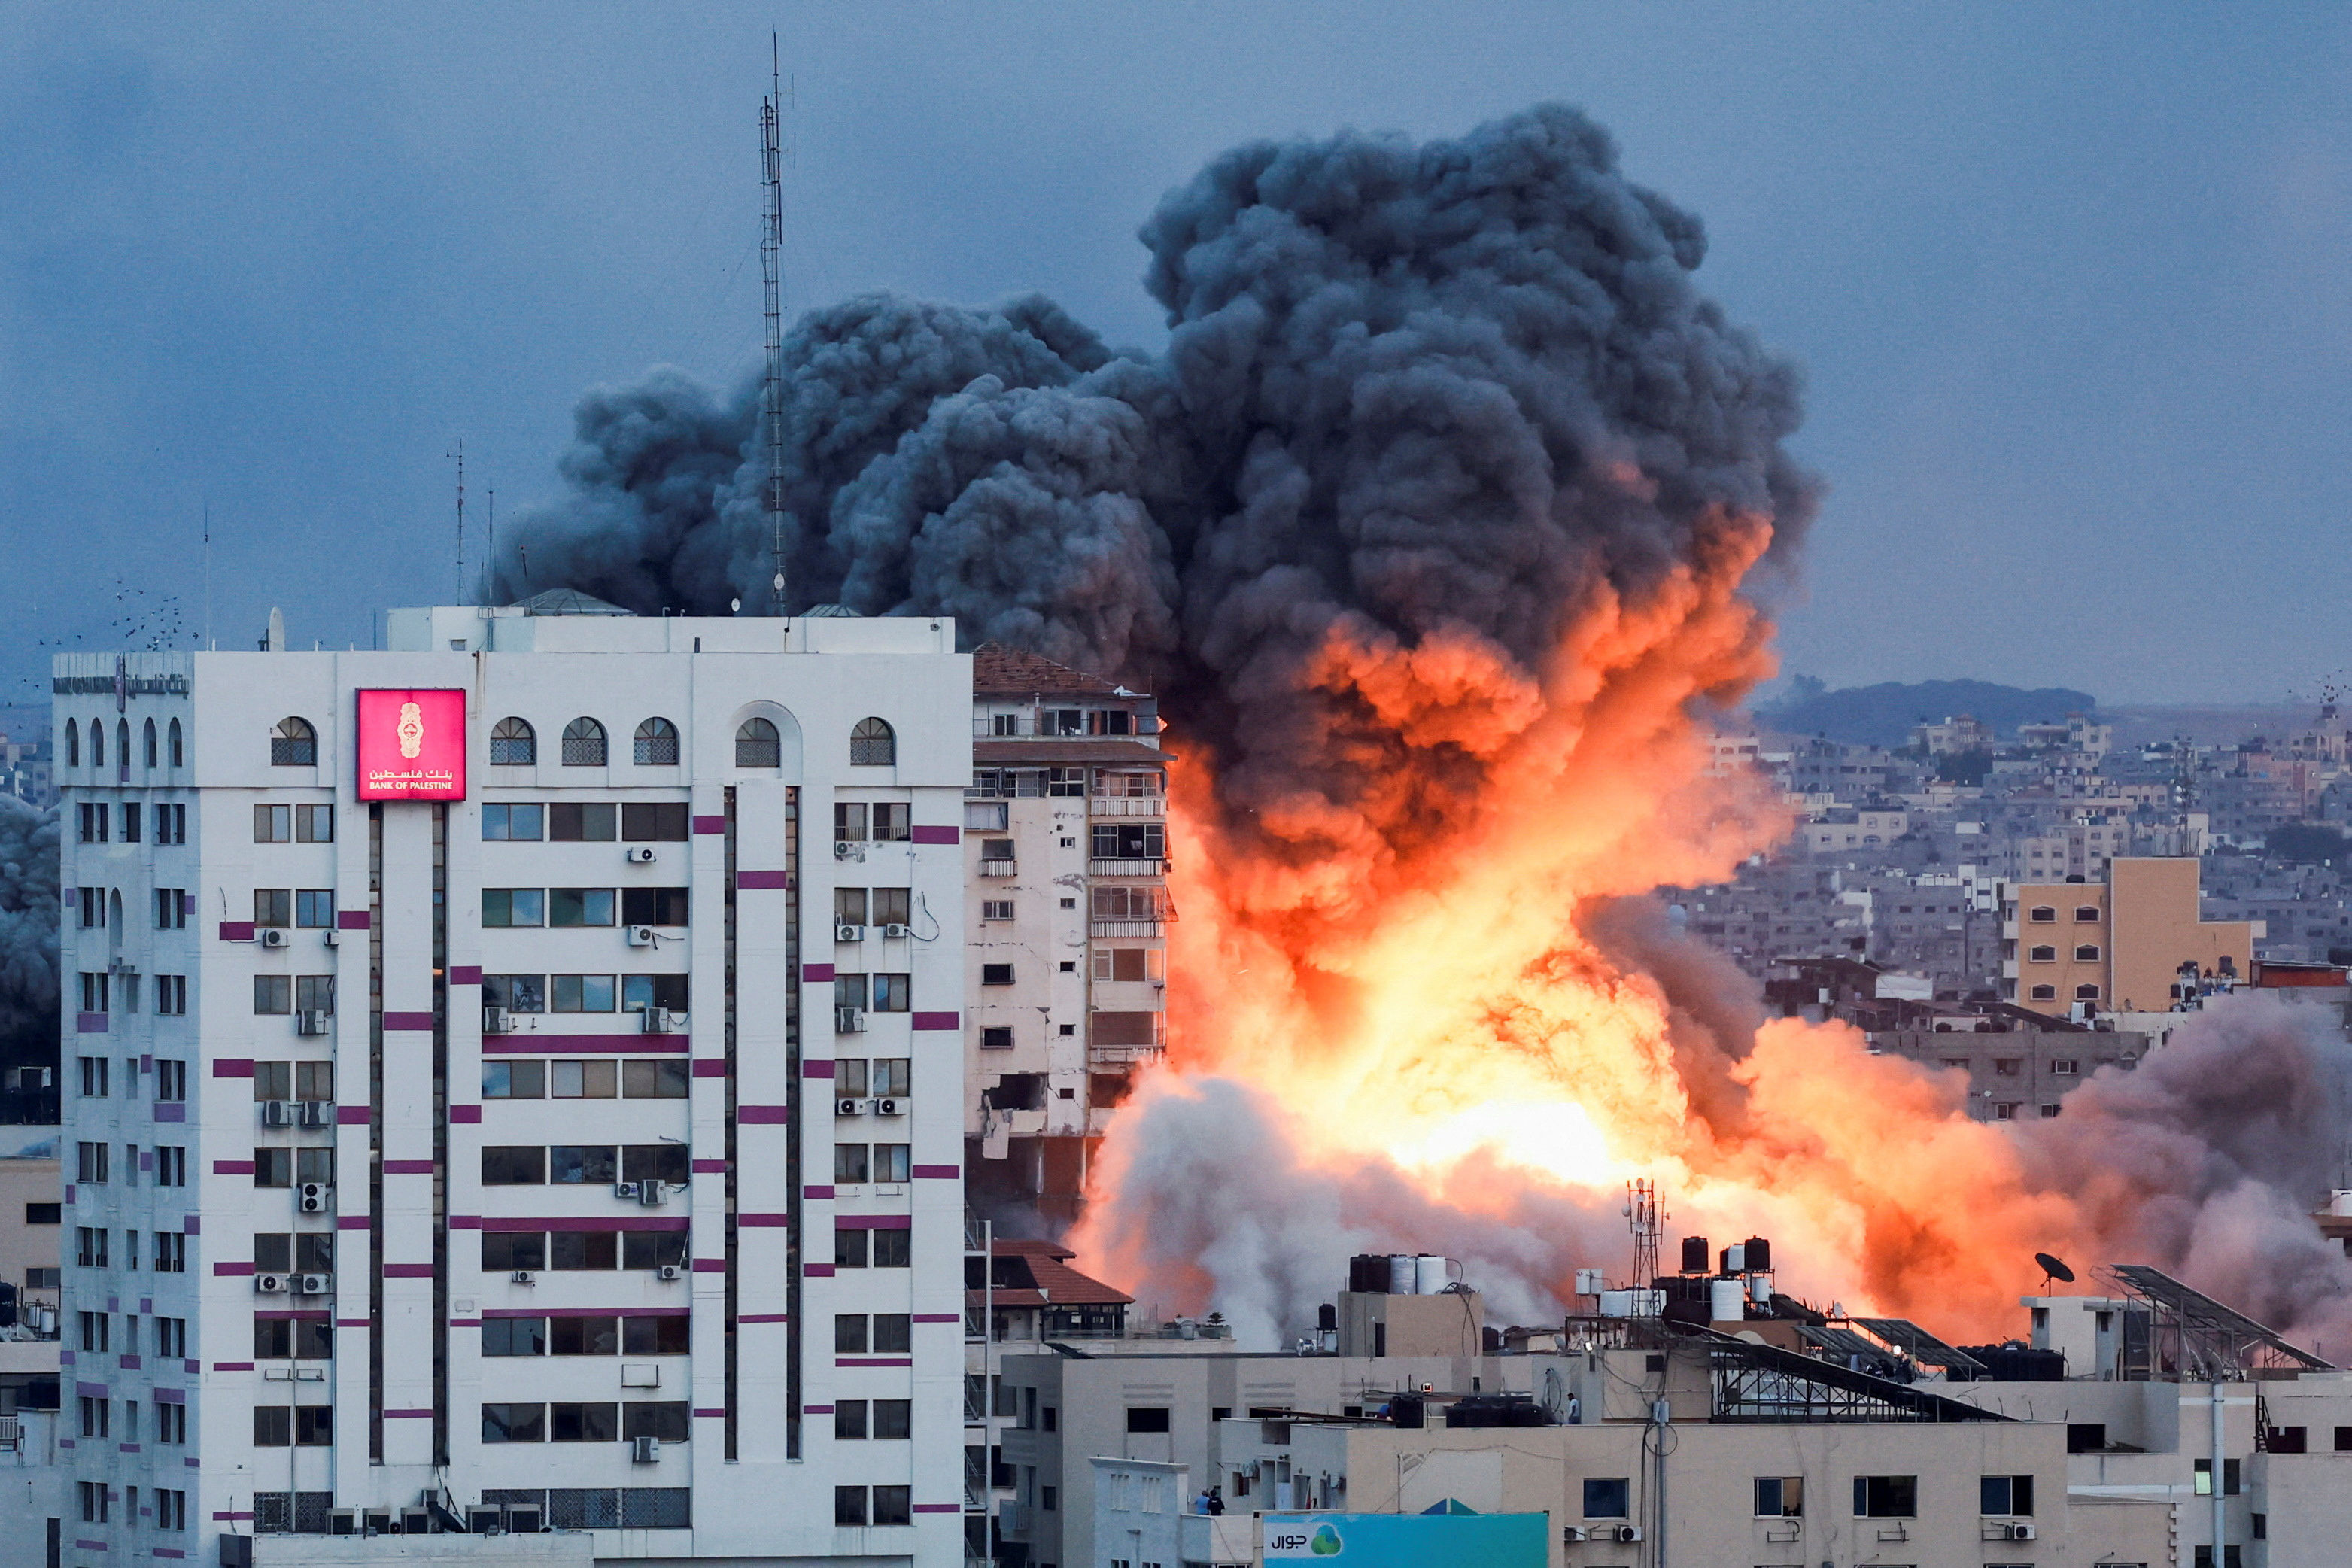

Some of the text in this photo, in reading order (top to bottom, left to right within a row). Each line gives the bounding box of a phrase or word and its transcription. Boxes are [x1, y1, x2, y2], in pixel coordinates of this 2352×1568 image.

[369, 770, 452, 780] بنك فلسطين
[1272, 1536, 1306, 1549] جوال
